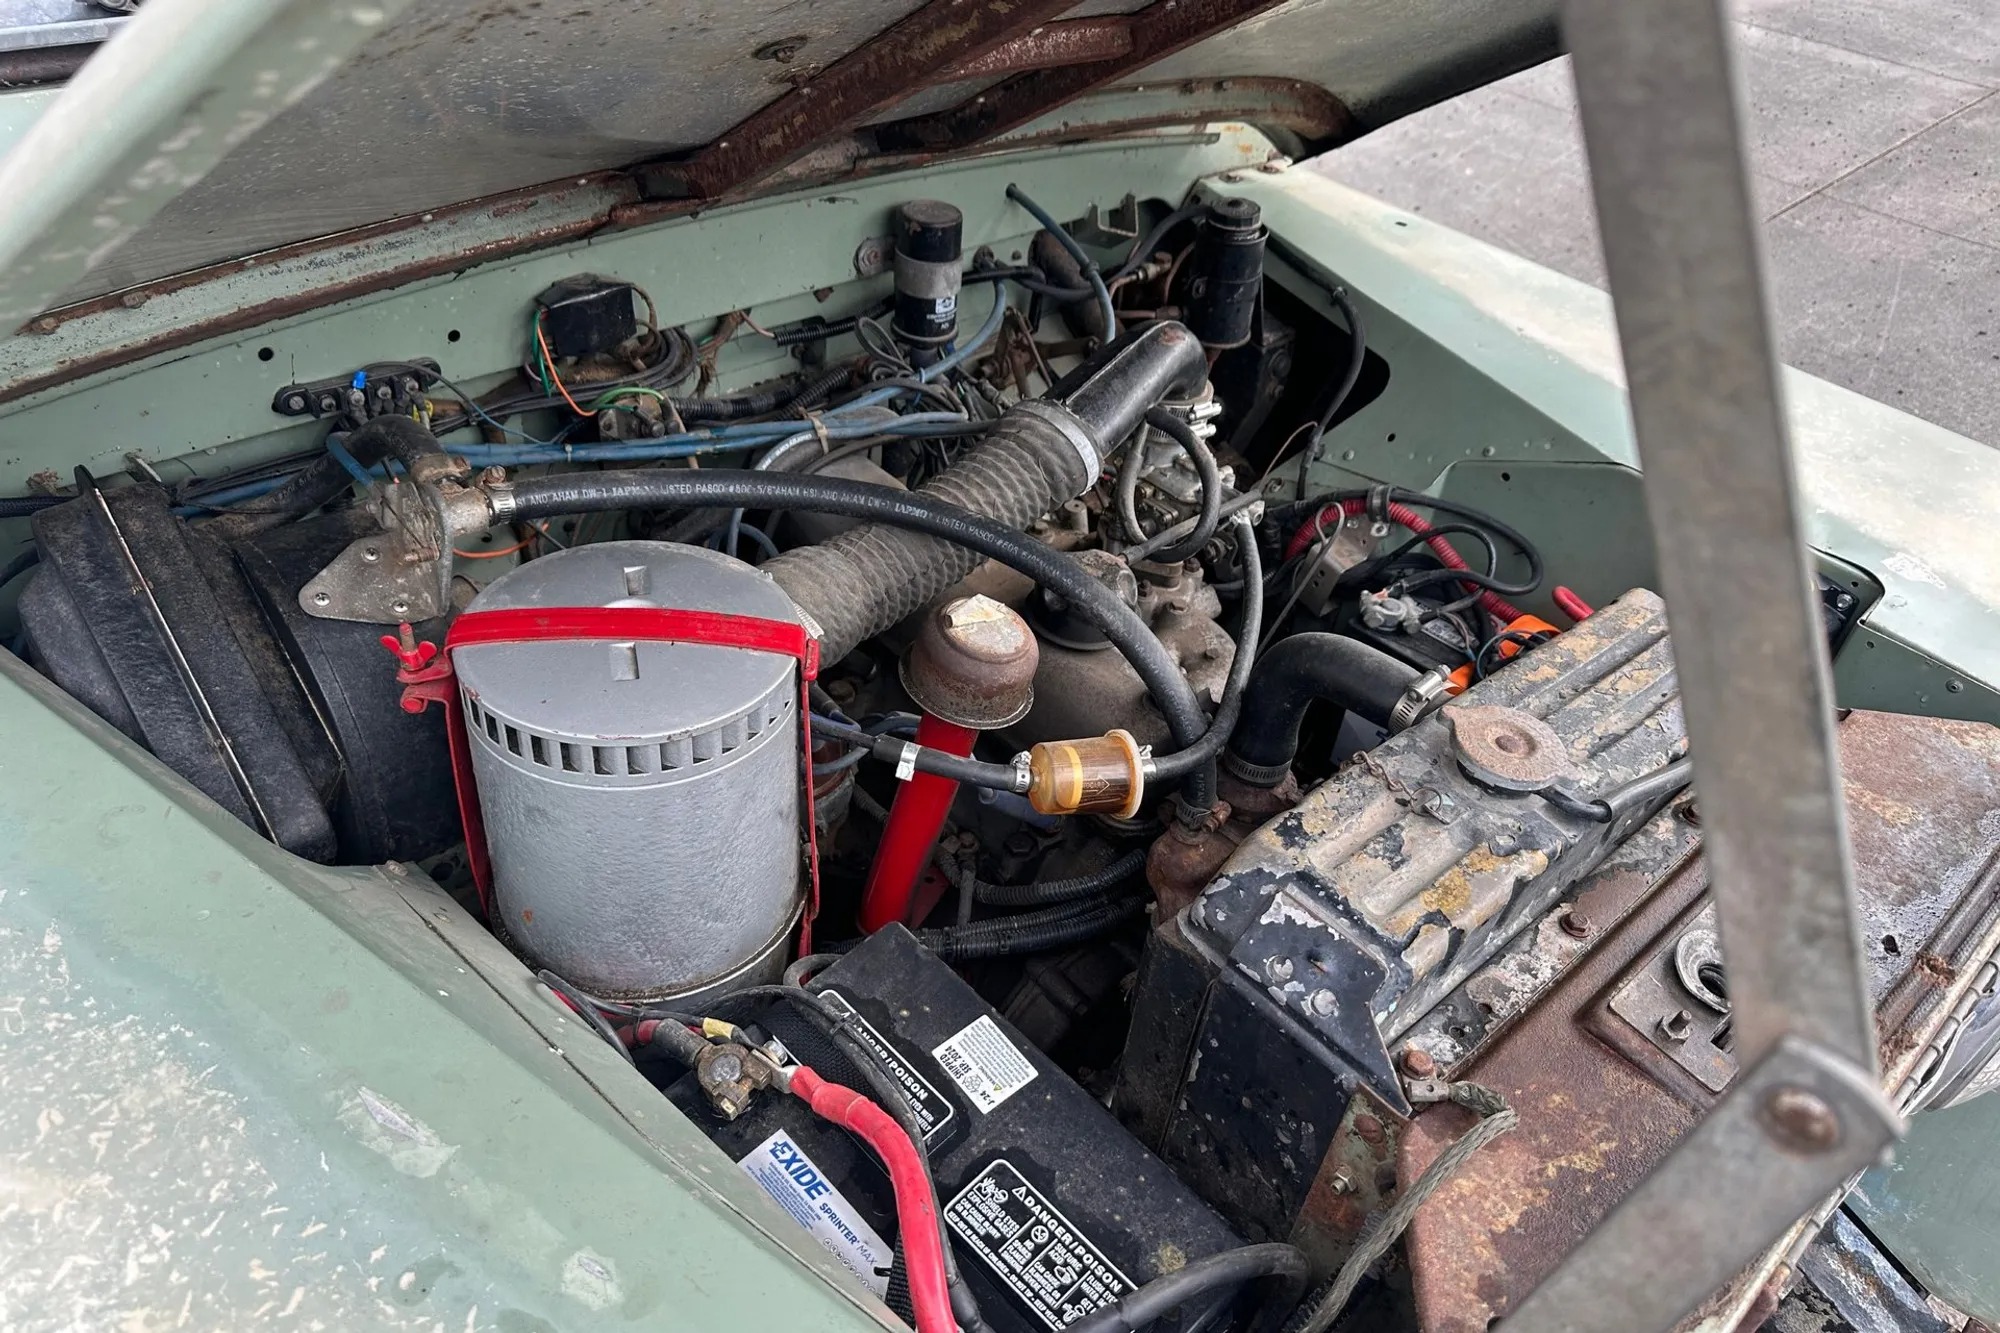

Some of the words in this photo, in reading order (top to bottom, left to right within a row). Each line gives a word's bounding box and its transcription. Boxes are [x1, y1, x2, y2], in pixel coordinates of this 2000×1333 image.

[552, 489, 579, 502] AHAM
[661, 483, 692, 496] LISTED
[695, 484, 725, 494] PASCO
[853, 1025, 928, 1100] ANGER/POISON
[944, 1044, 962, 1062] 2024
[939, 1053, 964, 1079] SHIPPED
[958, 1059, 972, 1074] SEP.
[979, 1089, 995, 1105] J-24
[769, 1141, 829, 1200] EXIDE
[959, 1197, 972, 1209] CAN
[968, 1206, 985, 1223] CAUSE
[966, 1190, 996, 1221] EXPLOSIVE
[993, 1217, 1014, 1238] GASES
[984, 1197, 1005, 1218] SHIELD
[1002, 1215, 1020, 1232] EYES
[818, 1202, 857, 1244] SPRINTER
[855, 1244, 878, 1266] MAX
[1022, 1238, 1035, 1250] NO
[1024, 1196, 1121, 1291] DANGER/POISON
[1006, 1244, 1027, 1265] FLAMES
[1047, 1248, 1064, 1264] ACID
[1054, 1242, 1082, 1271] SULFURIC
[1042, 1270, 1060, 1288] CAUSE
[1085, 1274, 1105, 1294] FLUSH
[1080, 1281, 1099, 1300] WATER
[1080, 1297, 1094, 1310] GET
